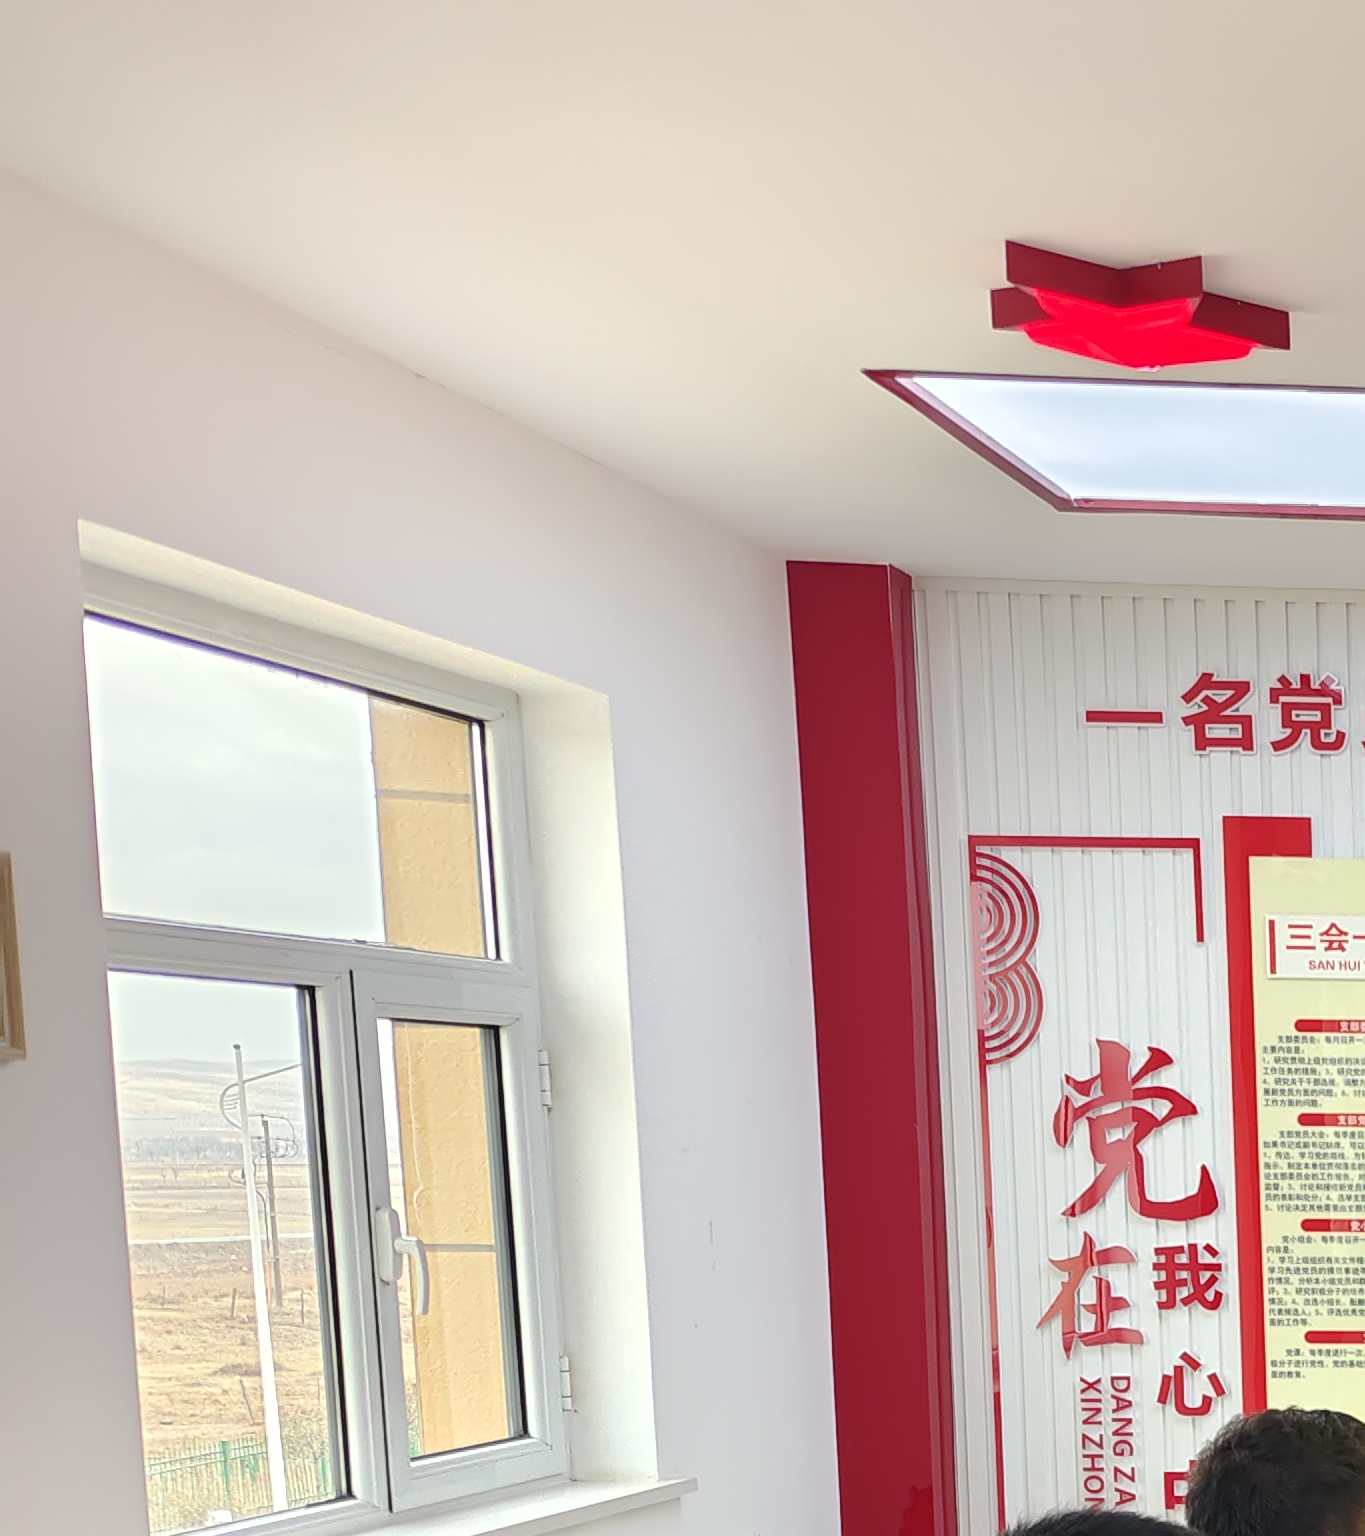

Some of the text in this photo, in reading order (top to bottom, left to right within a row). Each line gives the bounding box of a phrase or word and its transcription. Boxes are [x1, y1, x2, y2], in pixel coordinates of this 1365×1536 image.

[1308, 960, 1336, 971] SAN
[1338, 961, 1360, 971] HUI
[1080, 1376, 1103, 1426] XIN
[1110, 1375, 1137, 1515] DANG ZA
